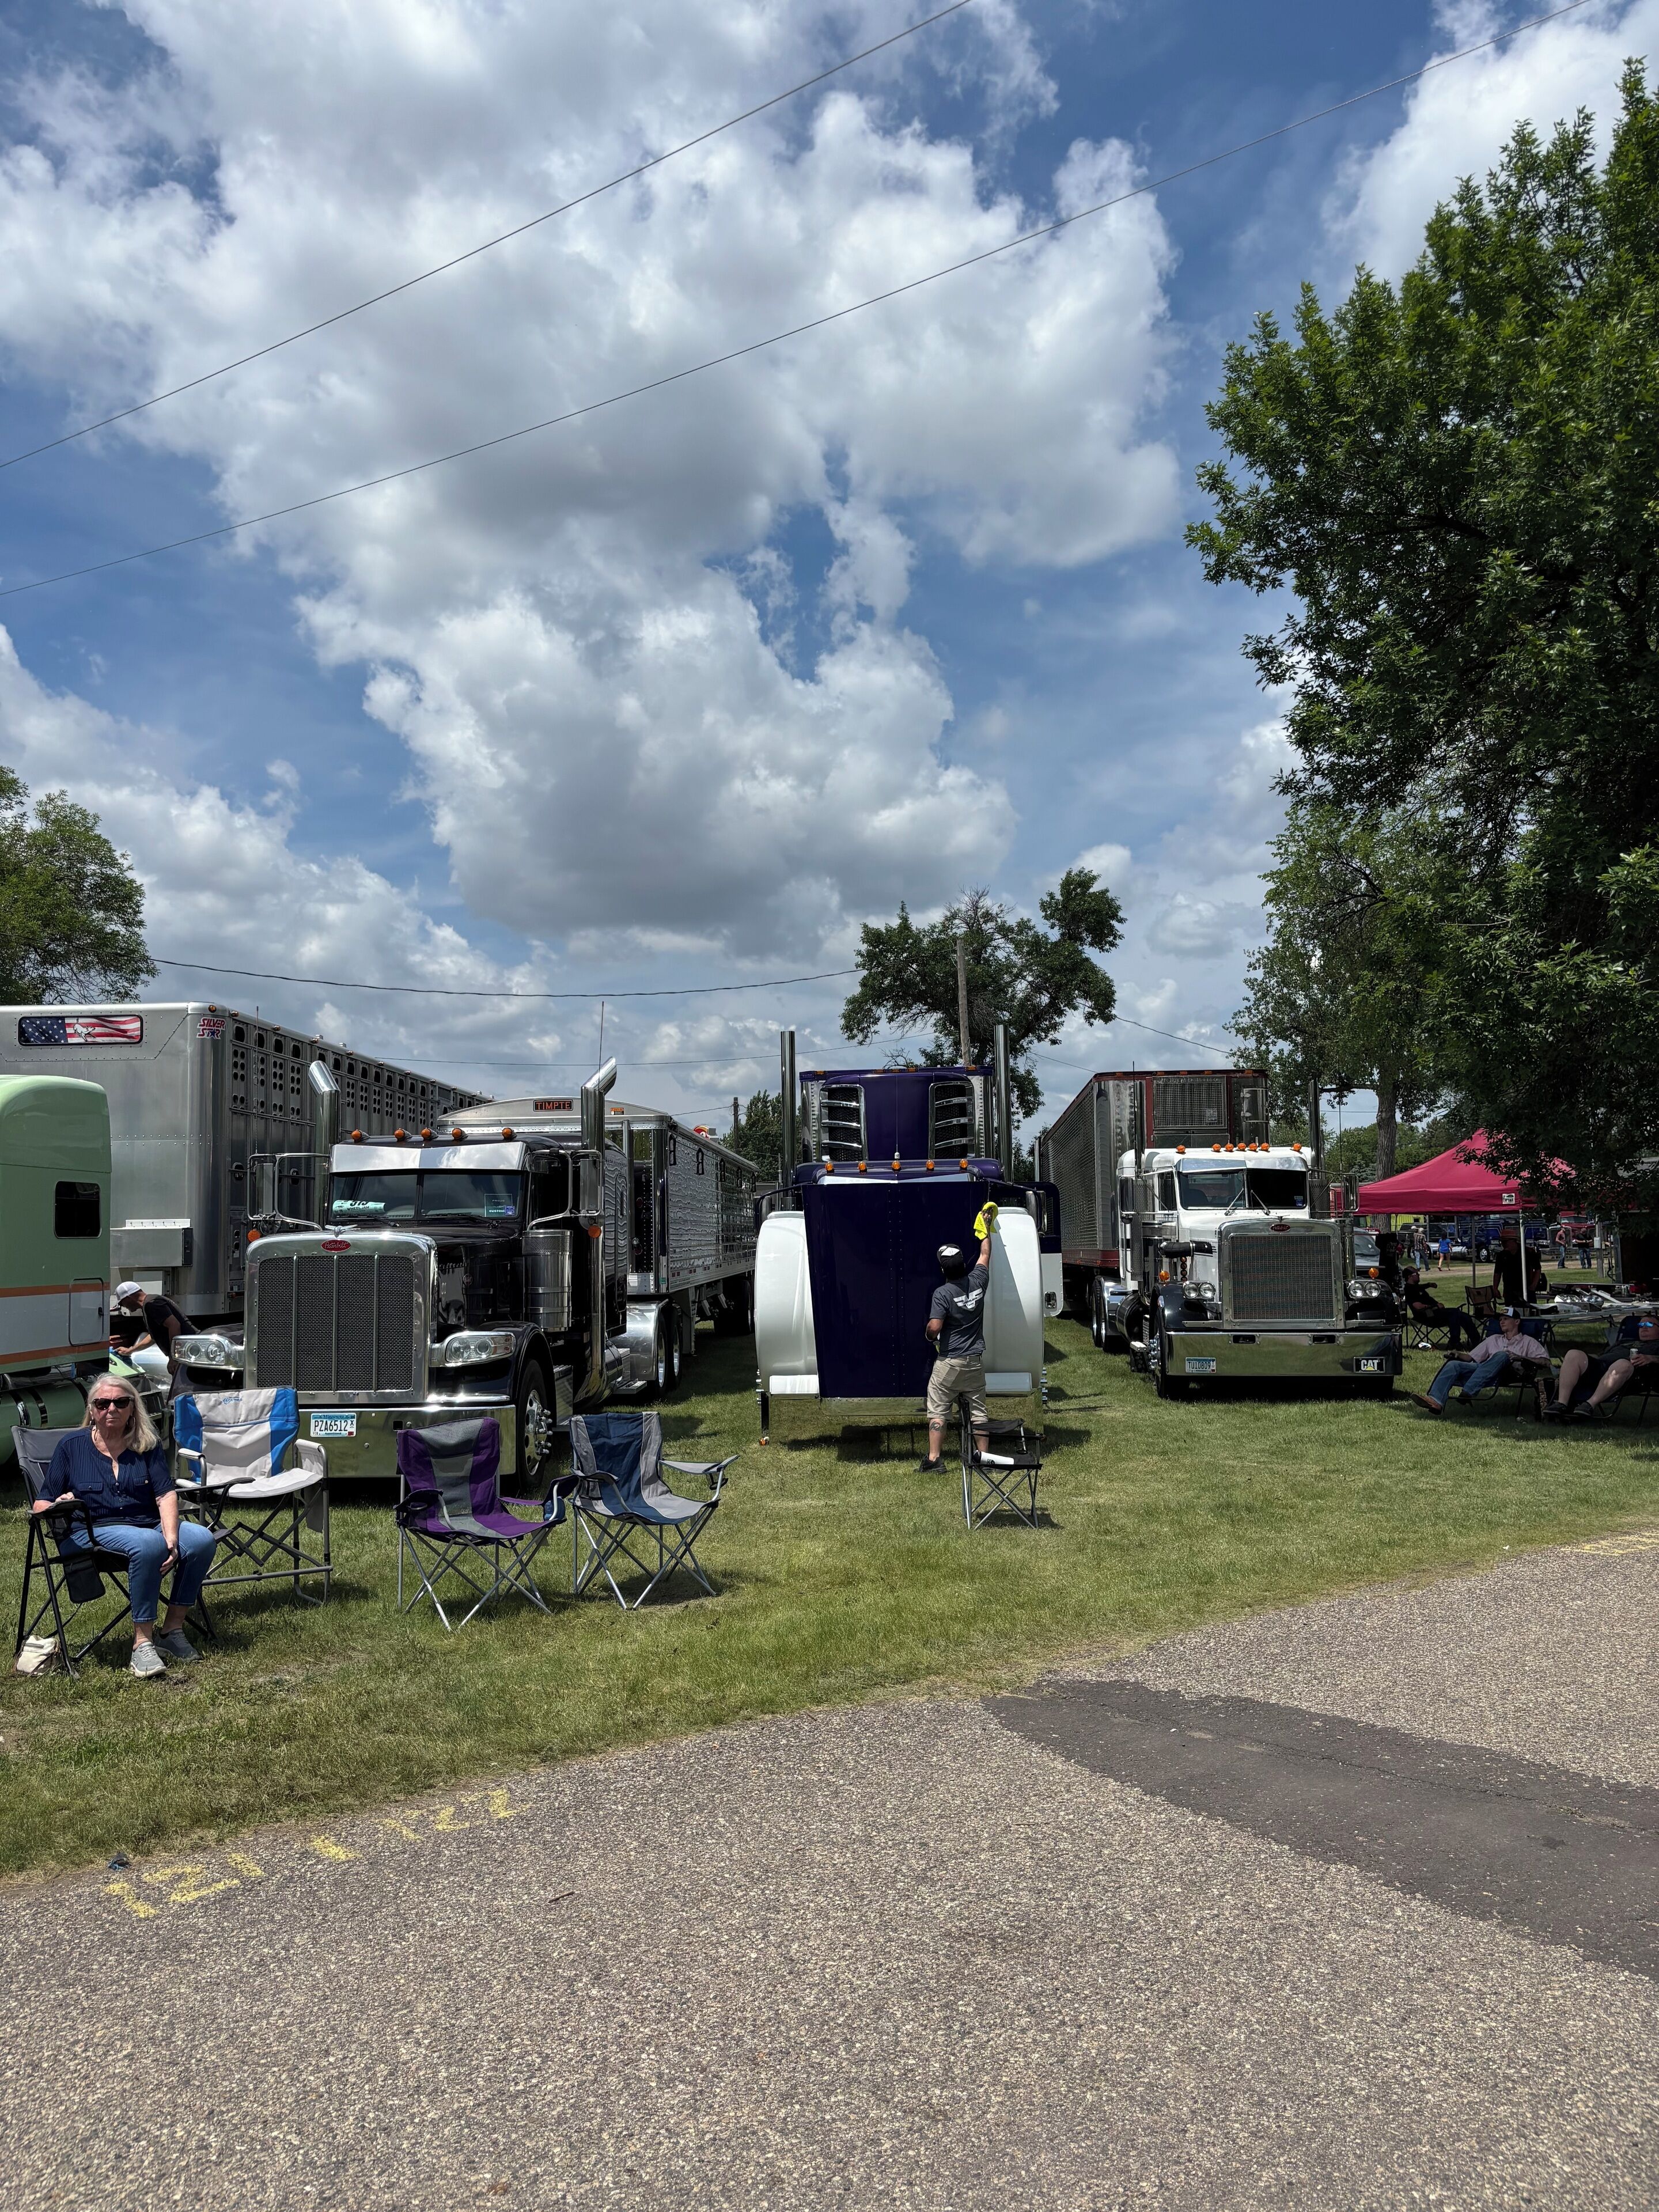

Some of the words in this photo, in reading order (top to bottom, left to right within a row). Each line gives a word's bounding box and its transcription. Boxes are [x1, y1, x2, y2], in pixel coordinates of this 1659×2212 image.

[198, 1018, 226, 1029] SILVER
[536, 1101, 571, 1110] TIMPTE
[1188, 1361, 1211, 1369] TU10809
[1361, 1359, 1378, 1371] CAT
[314, 1420, 348, 1431] PZA6512
